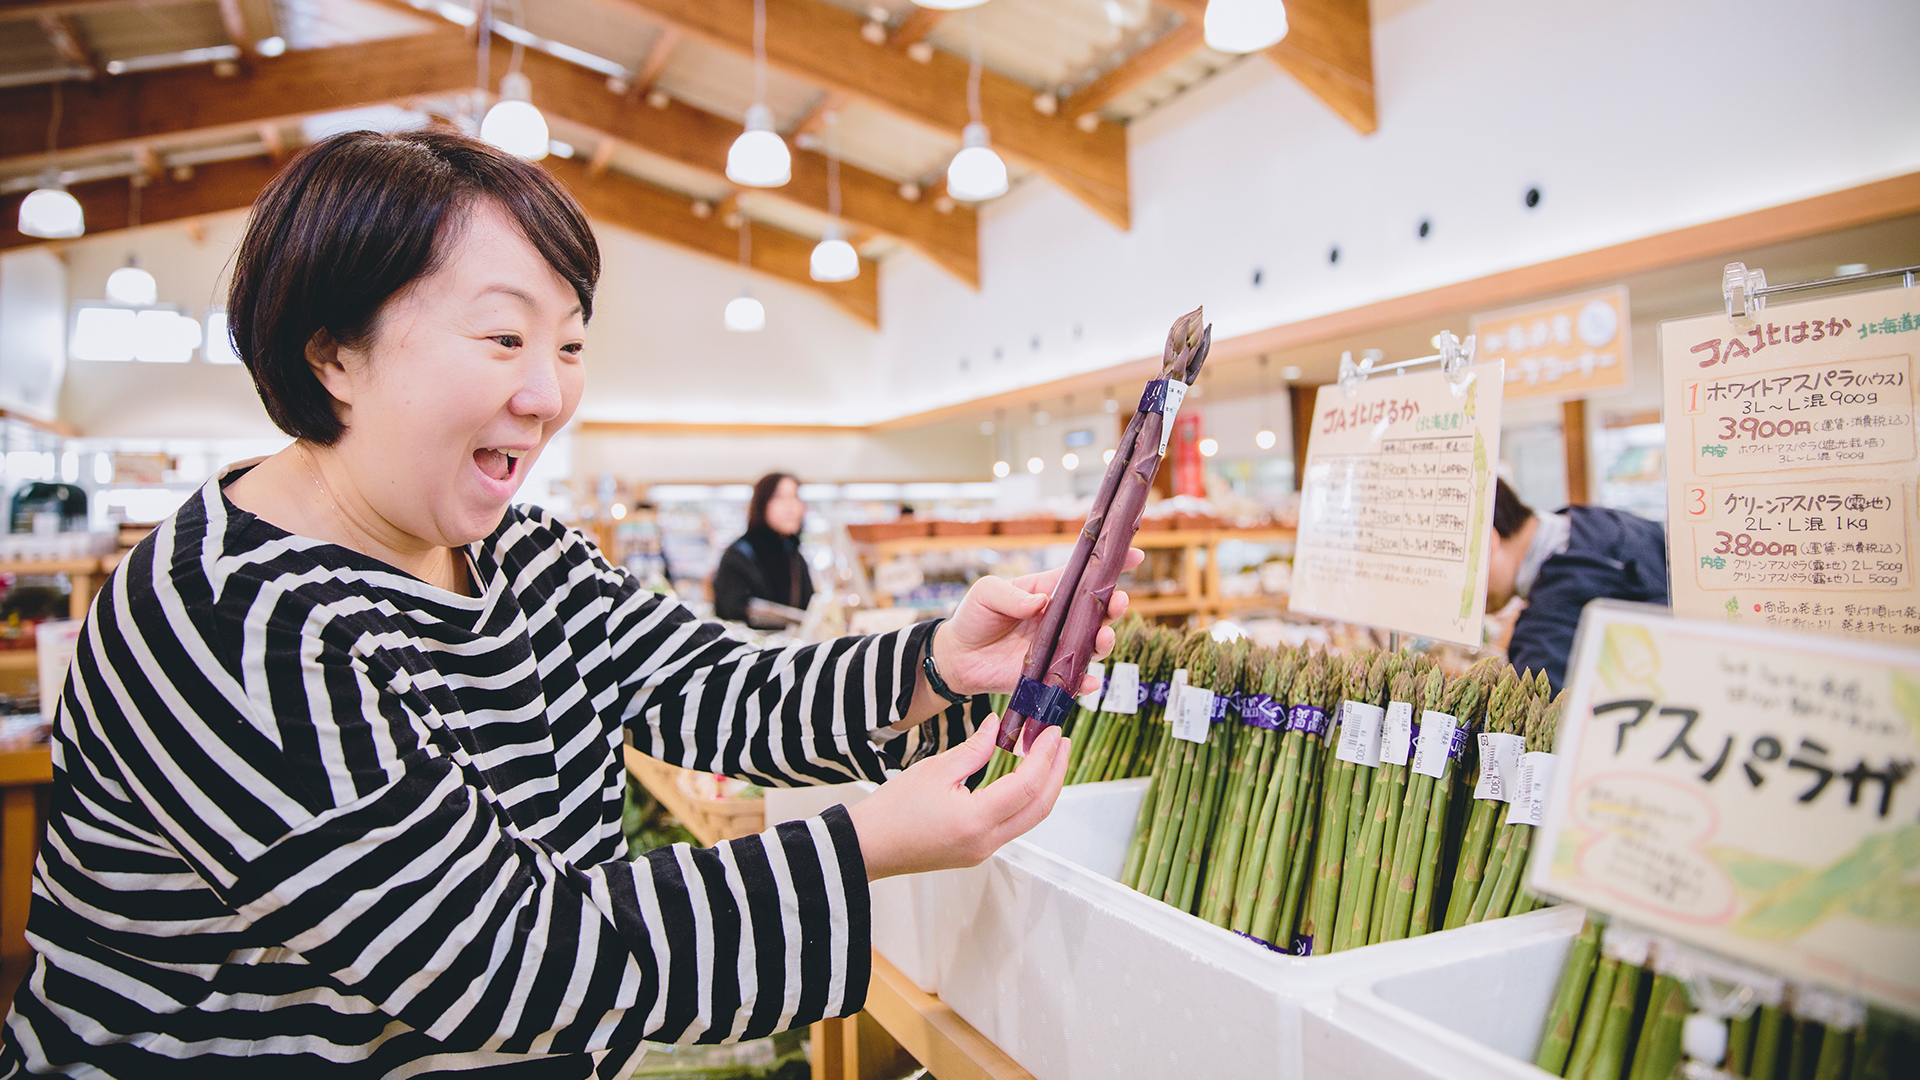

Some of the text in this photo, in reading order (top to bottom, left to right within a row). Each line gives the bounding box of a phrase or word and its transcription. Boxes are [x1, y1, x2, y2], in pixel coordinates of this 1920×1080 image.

[1690, 317, 1852, 368] JA北はるか
[1688, 382, 1699, 412] 1
[1701, 444, 1728, 458] 内容
[1688, 488, 1707, 515] 3
[1701, 556, 1726, 570] 内容
[1490, 774, 1501, 795] ¥300
[1530, 798, 1543, 821] ¥300
